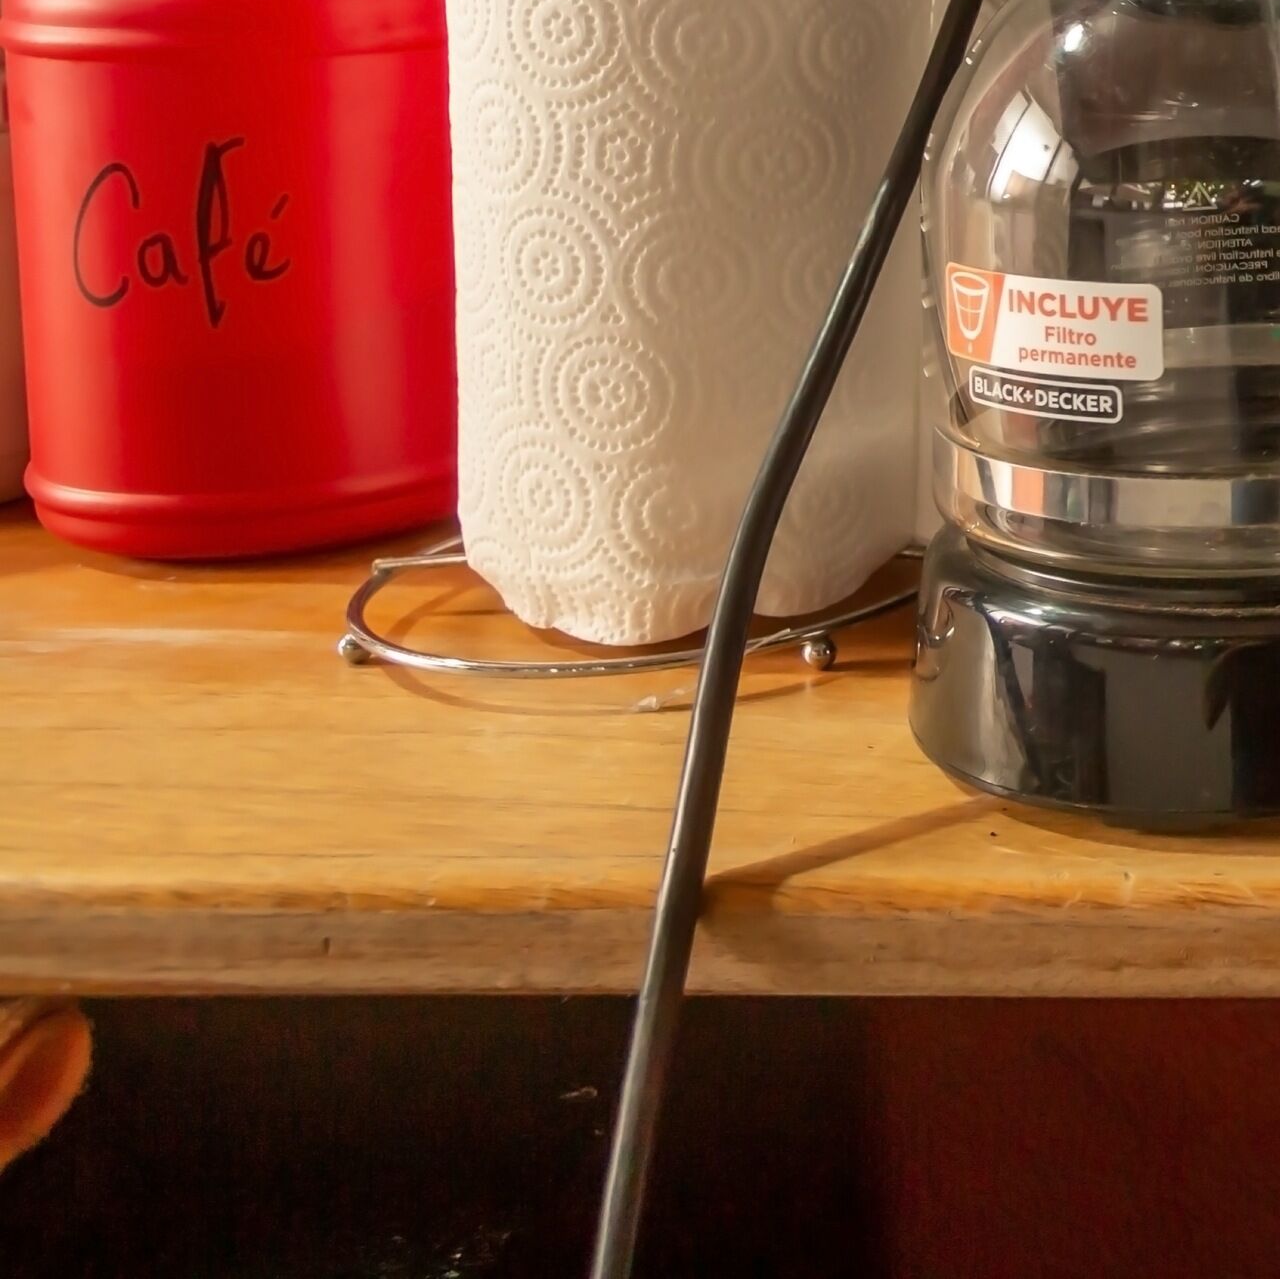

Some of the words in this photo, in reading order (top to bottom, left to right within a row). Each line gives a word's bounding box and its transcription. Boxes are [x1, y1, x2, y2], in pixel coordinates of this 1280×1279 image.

[74, 136, 291, 329] Café
[1008, 289, 1149, 322] INCLUYE
[1045, 325, 1097, 346] Filtro
[1018, 347, 1137, 368] permanente
[974, 377, 1113, 413] BLACK+DECKER
